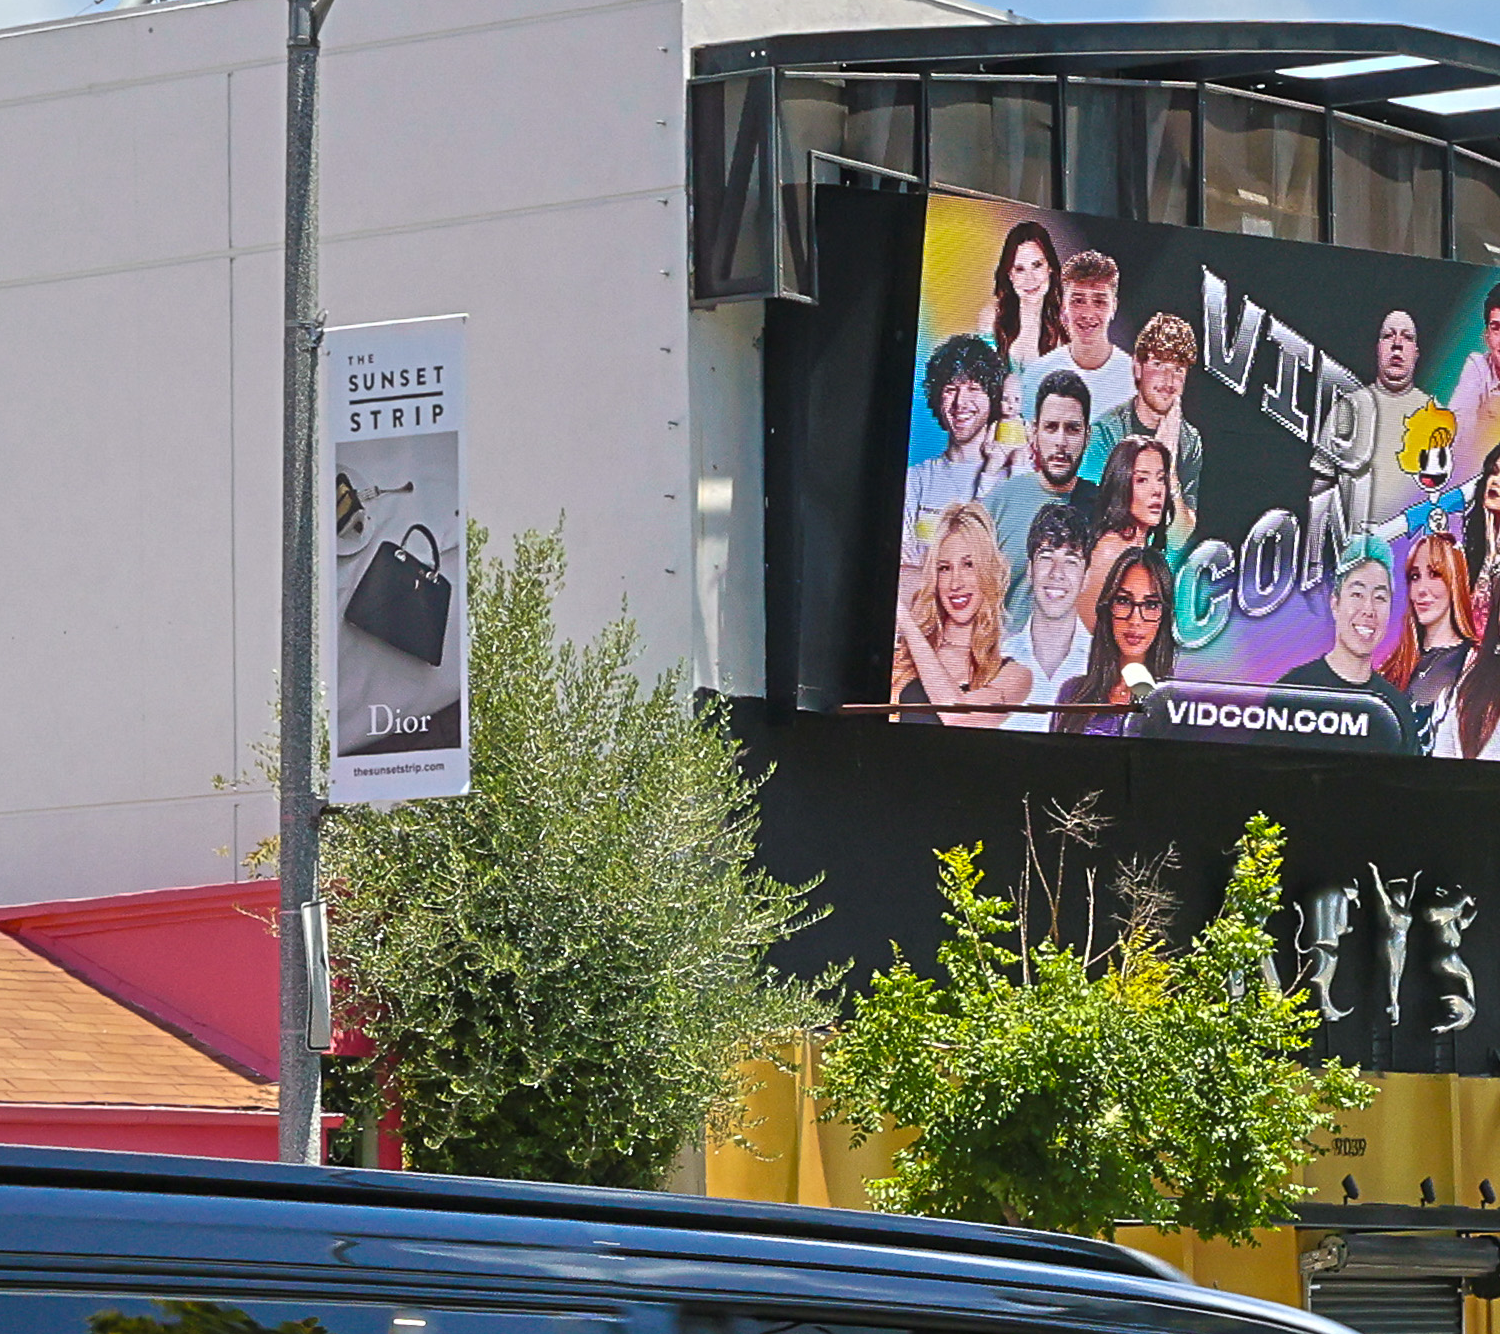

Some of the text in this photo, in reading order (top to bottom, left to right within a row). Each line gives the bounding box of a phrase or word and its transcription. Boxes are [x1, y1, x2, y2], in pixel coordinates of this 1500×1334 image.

[348, 354, 374, 365] THE
[1202, 265, 1377, 473] VID
[349, 366, 443, 392] SUNSET
[350, 404, 444, 432] STRIP
[367, 704, 431, 736] Dior
[1167, 699, 1369, 736] VIDCON.COM
